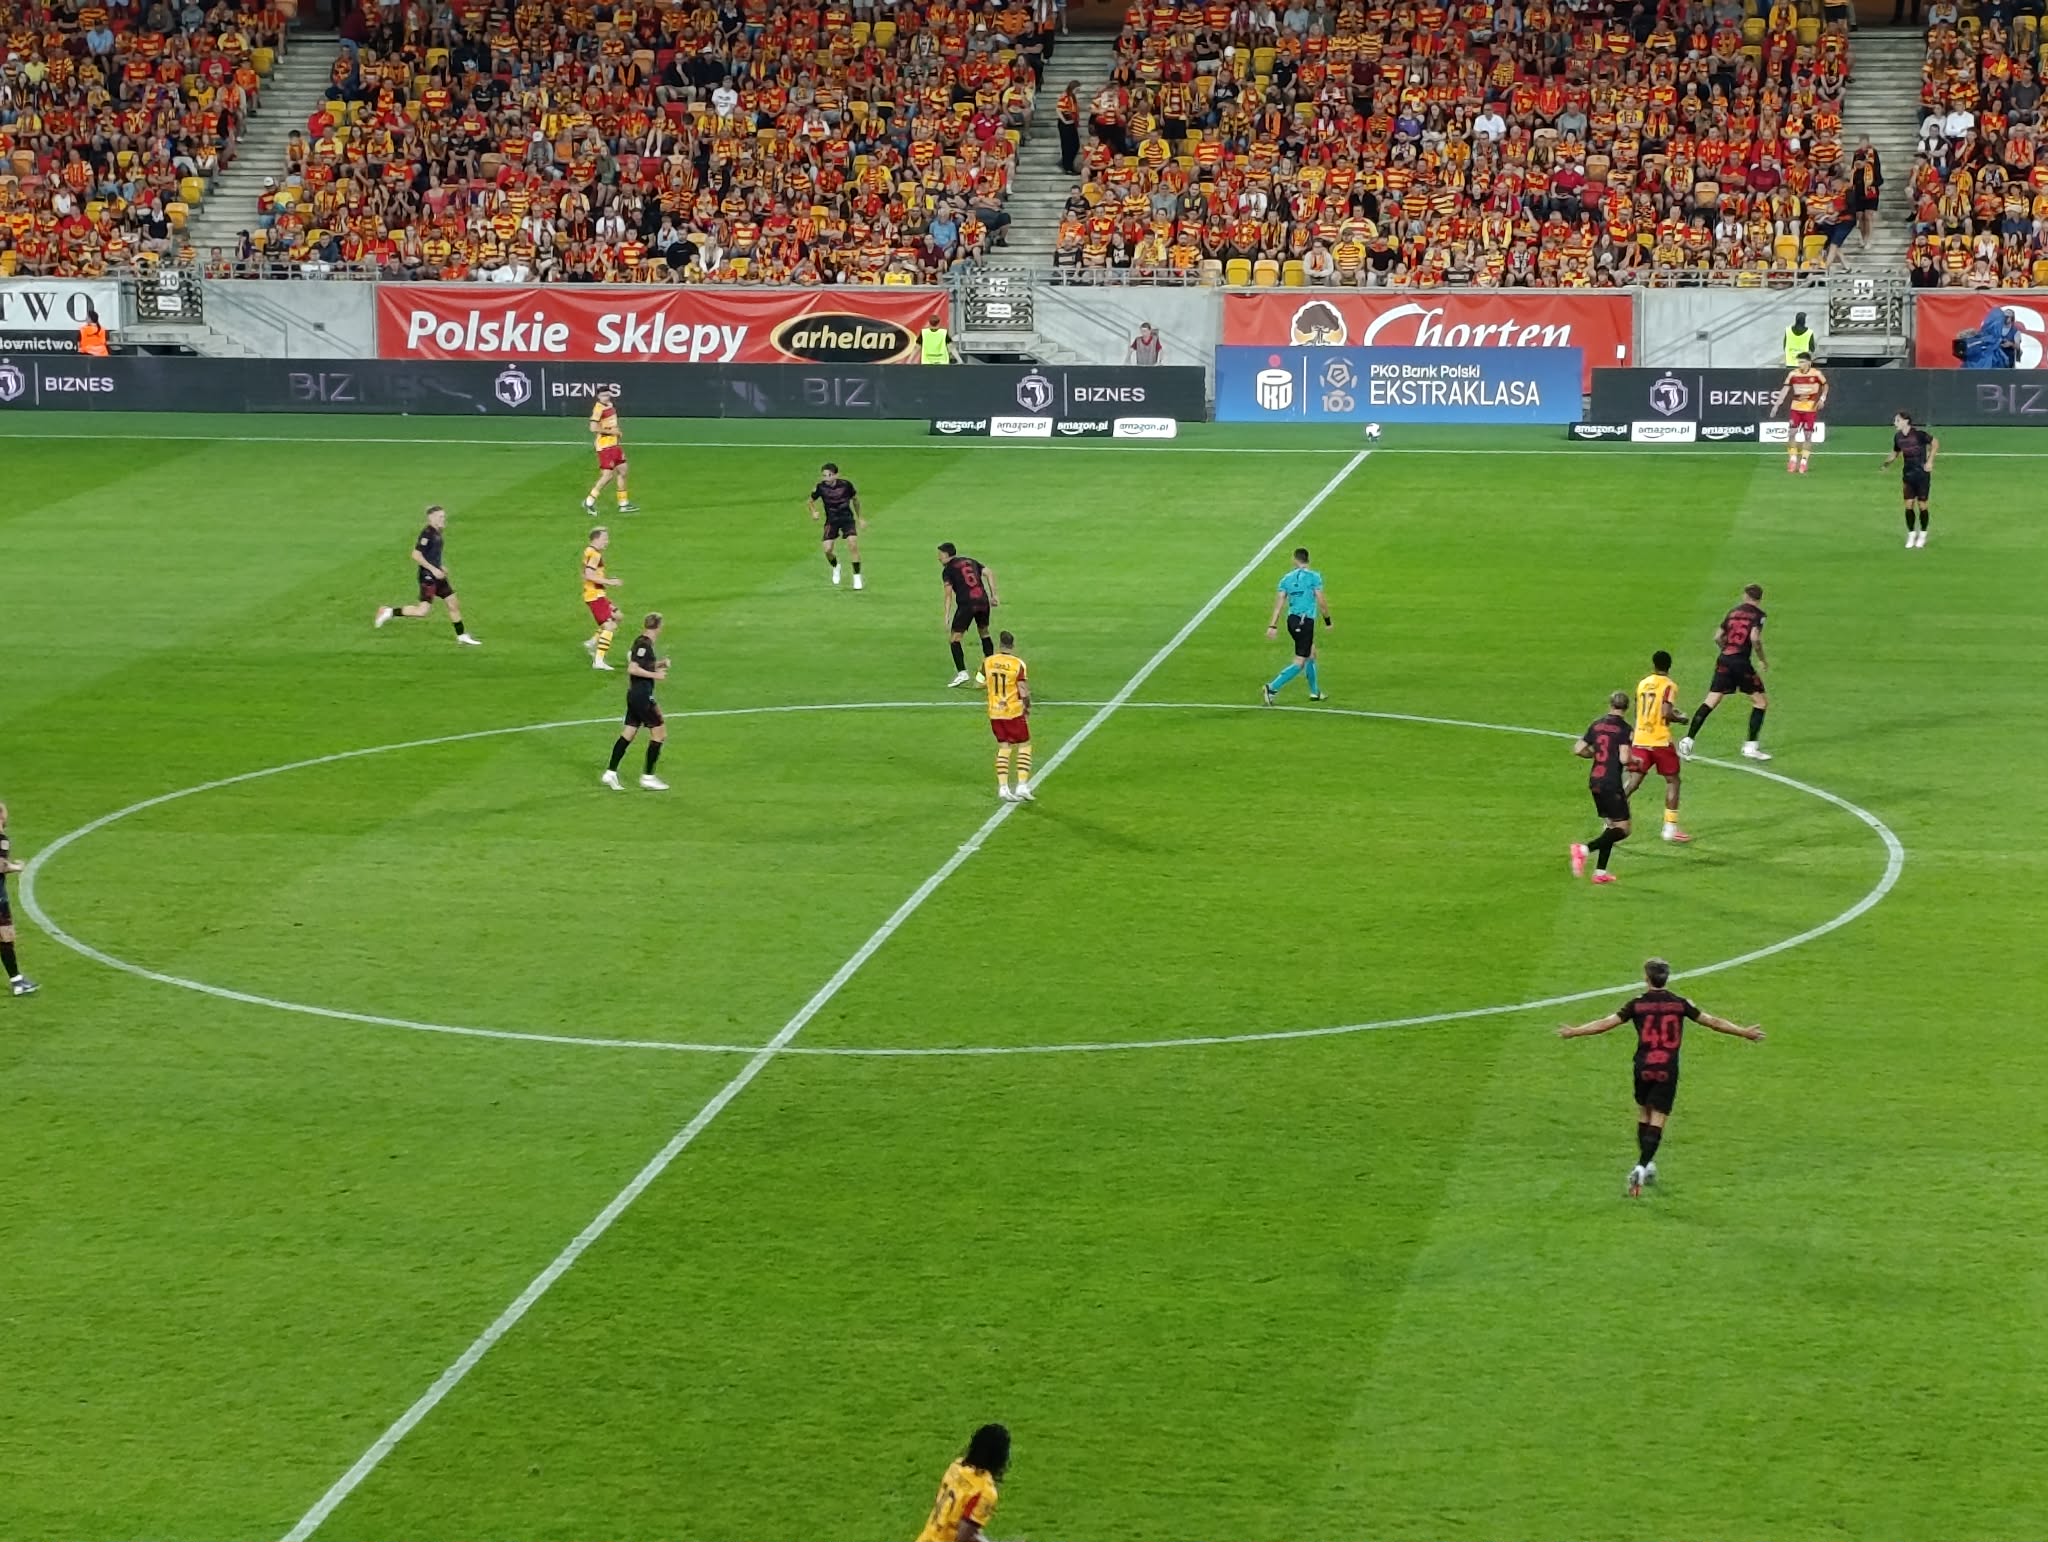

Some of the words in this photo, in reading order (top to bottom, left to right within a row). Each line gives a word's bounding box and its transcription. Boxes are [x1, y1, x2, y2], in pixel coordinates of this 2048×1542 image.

[1363, 303, 1571, 347] Chorten
[407, 310, 570, 353] Polskie
[594, 311, 749, 362] Sklepy
[791, 325, 896, 350] arhelan
[0, 337, 78, 351] ownictwo.
[1370, 364, 1400, 378] PKO
[1402, 364, 1438, 378] Bank
[1440, 364, 1481, 378] Polski
[45, 377, 114, 392] BIZNES
[552, 382, 621, 398] BIZNS
[1074, 387, 1145, 402] BIZNES
[1370, 380, 1540, 406] EKSTRAKLASA
[936, 419, 986, 432] amazon.pl
[997, 421, 1047, 431] amazon.pl
[1057, 420, 1109, 433] amazon.pl
[1119, 422, 1168, 432] amazon.pl
[1574, 424, 1628, 435] amazon.pl
[1638, 425, 1690, 435] amazon.pl
[1701, 424, 1754, 435] amazon.pl
[961, 566, 978, 588] 6
[991, 672, 1007, 698] 11
[1640, 691, 1657, 719] 17
[1596, 734, 1610, 762] 3
[1641, 1014, 1681, 1049] 40
